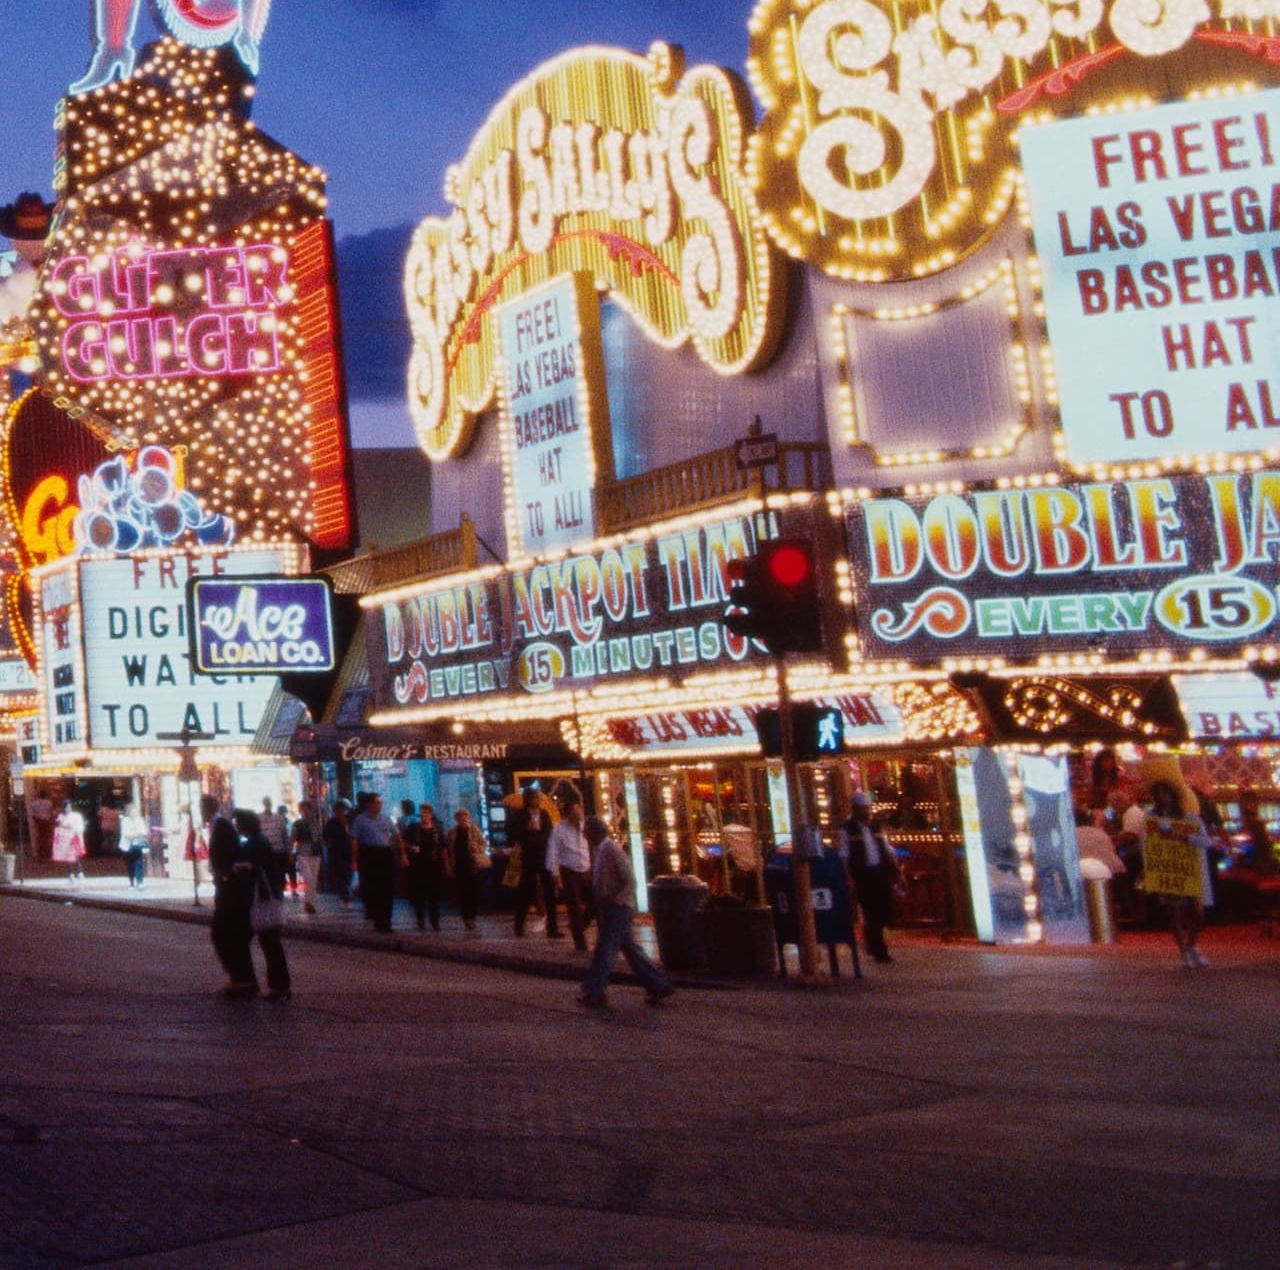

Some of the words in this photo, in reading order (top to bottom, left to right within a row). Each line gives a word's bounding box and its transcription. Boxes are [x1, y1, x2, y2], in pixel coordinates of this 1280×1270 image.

[1091, 112, 1274, 188] FREE!
[1057, 200, 1148, 257] LAS
[51, 240, 289, 318] GLITTER
[62, 312, 280, 382] GULCH
[534, 343, 576, 389] VEGAS
[1161, 316, 1256, 372] HAT
[514, 395, 580, 451] BASEBALL
[1109, 389, 1174, 440] TO
[539, 446, 563, 488] HAT
[526, 500, 544, 538] TO
[862, 477, 1188, 585] DOUBLE
[132, 553, 228, 589] FREE
[383, 583, 493, 663] DOUBLE
[498, 541, 650, 656] JACKPOT
[657, 512, 778, 612] TIM
[201, 585, 307, 641] Ace
[975, 591, 1154, 638] EVERY
[1179, 585, 1252, 630] 15
[122, 652, 256, 687] WAT
[210, 641, 278, 665] LOAN
[281, 640, 325, 664] CO.
[429, 658, 512, 698] EVERY
[527, 651, 552, 683] 15
[571, 621, 721, 679] MINUTES
[102, 703, 150, 738] TO
[182, 701, 257, 736] ALL
[1199, 711, 1280, 736] BAS
[339, 737, 417, 760] Cosmo's
[424, 744, 509, 760] RESTAURANT
